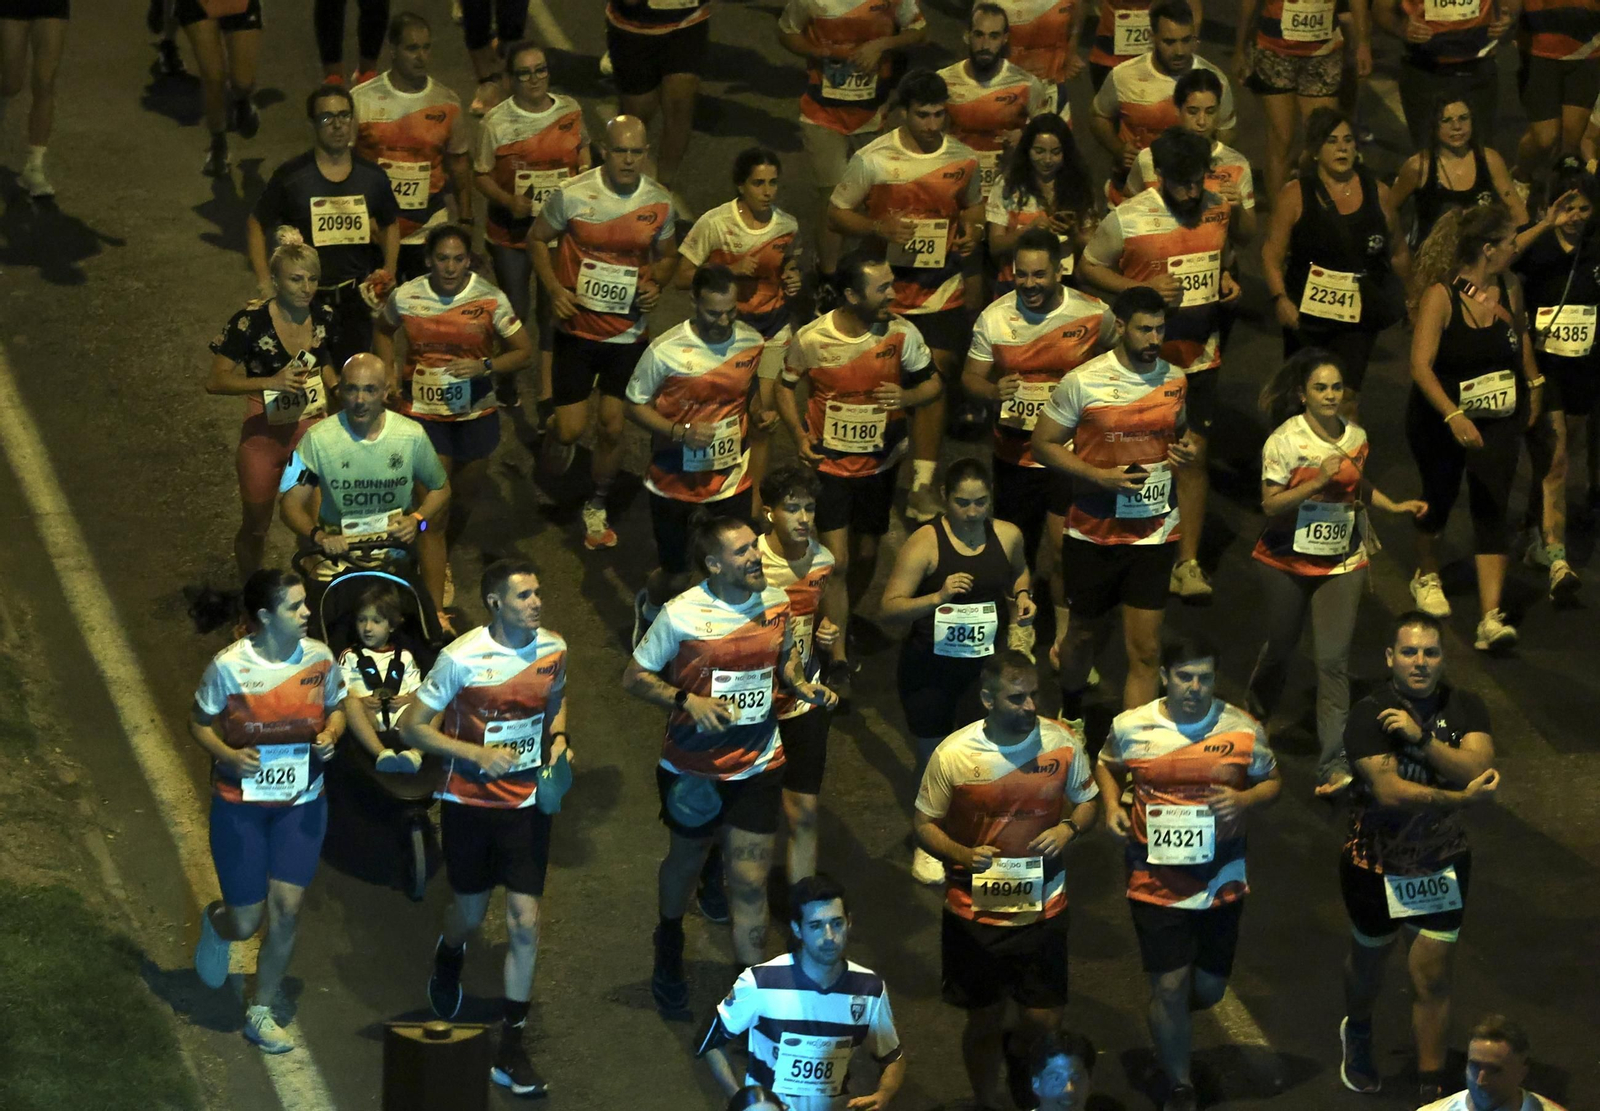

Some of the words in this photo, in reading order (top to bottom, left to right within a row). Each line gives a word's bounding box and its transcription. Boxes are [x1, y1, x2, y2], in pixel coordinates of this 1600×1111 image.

[1290, 13, 1324, 29] 6404
[318, 215, 363, 232] 20996
[583, 278, 628, 302] 10960
[1309, 286, 1355, 308] 22341
[273, 388, 318, 412] 19412
[418, 385, 463, 401] 10958
[1466, 391, 1509, 411] 22317
[1007, 397, 1045, 418] 2095
[831, 421, 878, 439] 11180
[692, 437, 735, 458] 11182
[343, 490, 395, 506] sano
[1304, 522, 1347, 541] 16396
[946, 626, 985, 643] 3845
[1203, 742, 1234, 757] KH7
[255, 766, 296, 785] 3626
[1153, 829, 1204, 848] 24321
[980, 880, 1034, 897] 18940
[1394, 876, 1449, 901] 10406
[791, 1060, 834, 1080] 5968
